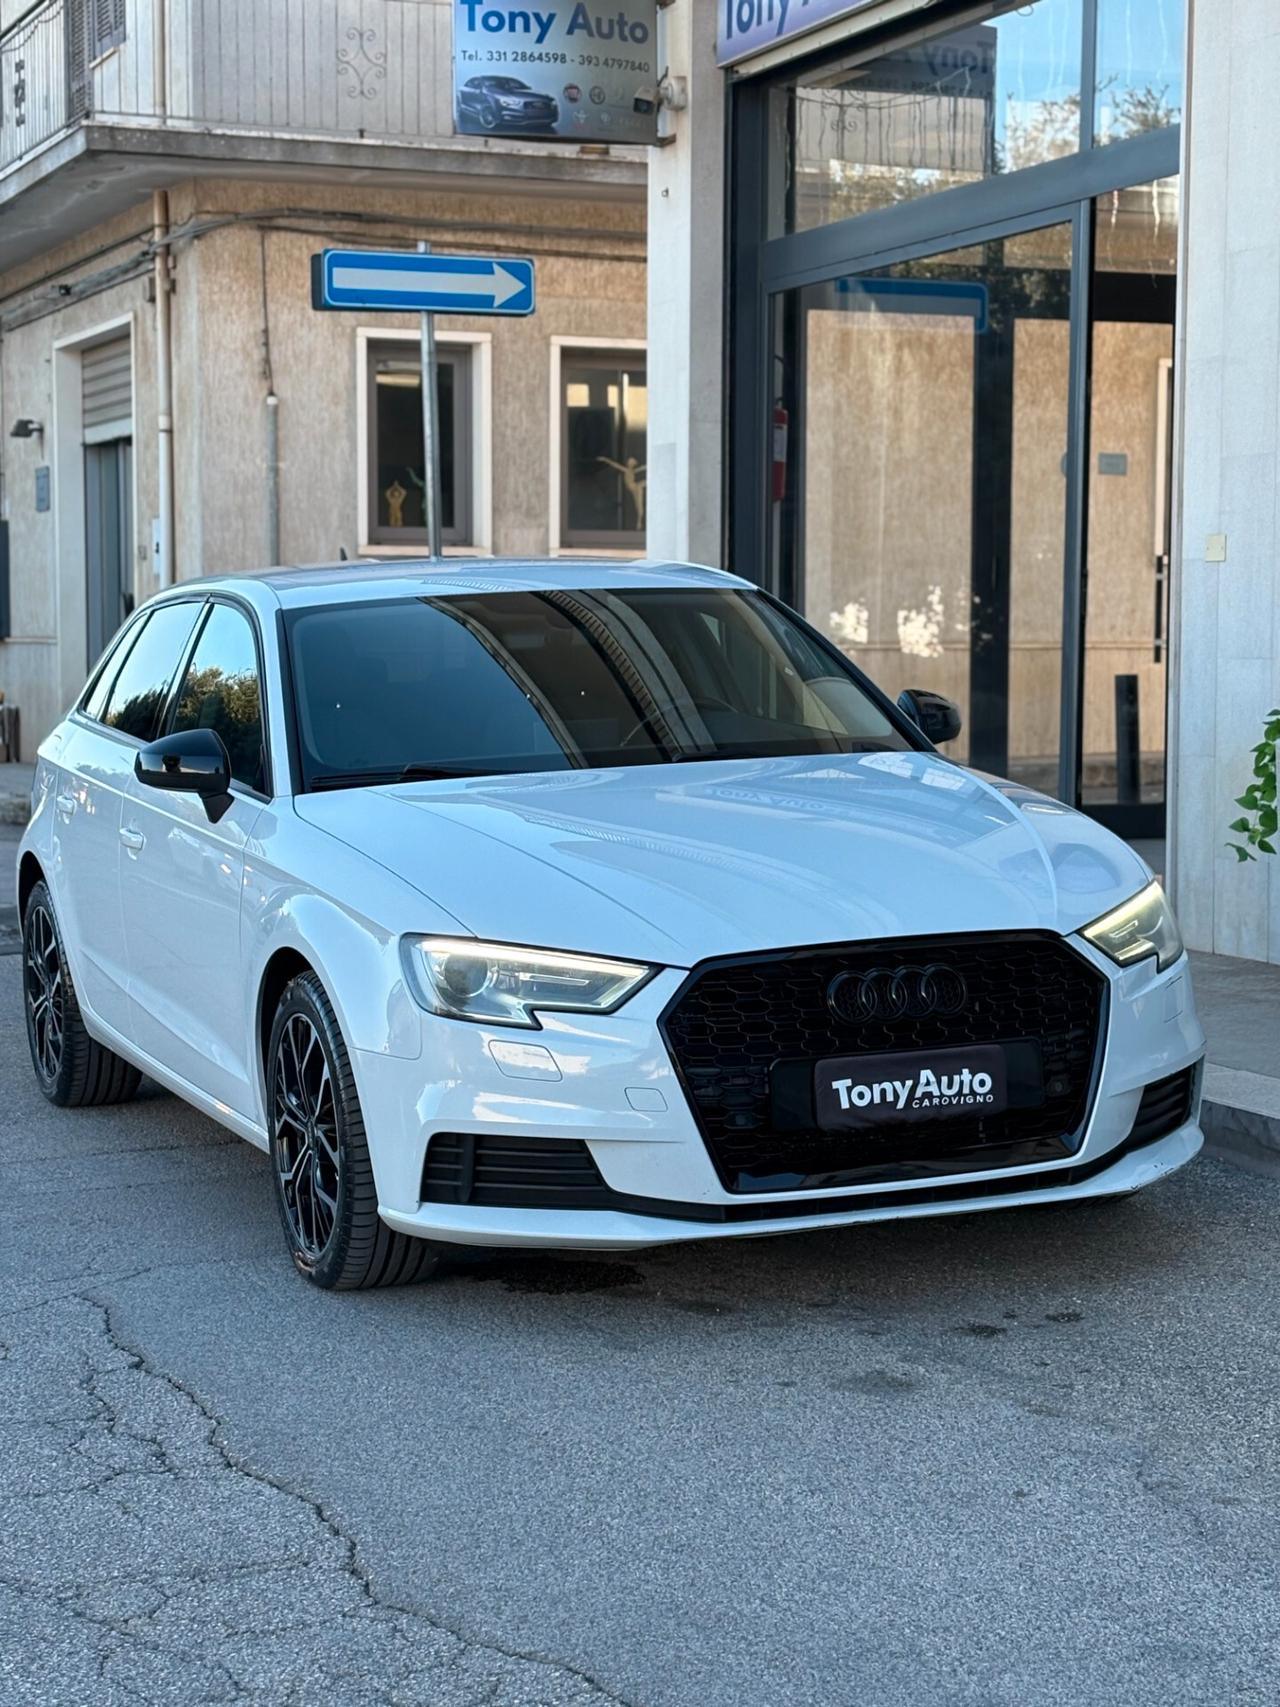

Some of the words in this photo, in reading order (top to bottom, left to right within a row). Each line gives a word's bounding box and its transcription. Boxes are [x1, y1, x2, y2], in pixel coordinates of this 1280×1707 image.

[460, 0, 557, 44] Tony
[566, 2, 649, 44] Auto
[461, 50, 482, 62] Tel.
[486, 50, 507, 62] 331
[511, 51, 567, 64] 2864598
[912, 1094, 994, 1108] CAROVIGNO
